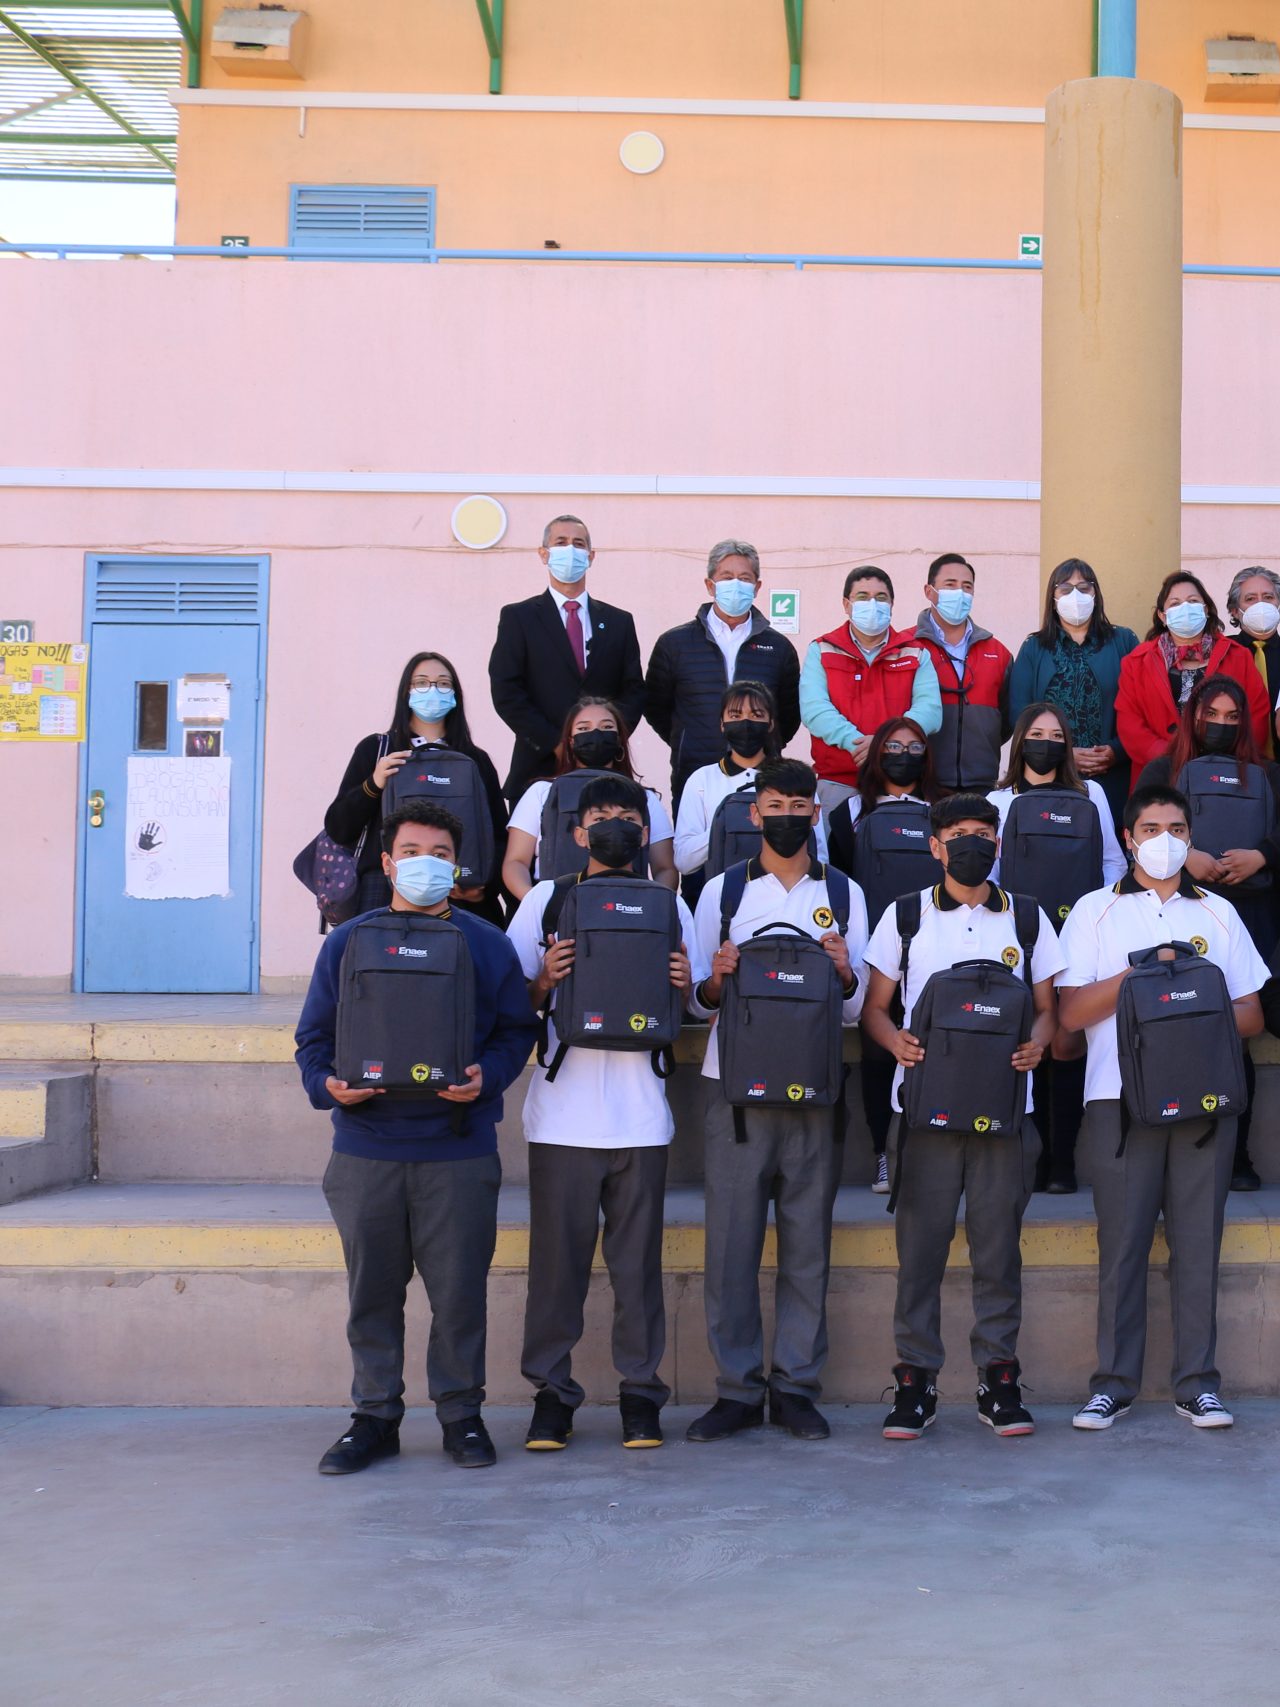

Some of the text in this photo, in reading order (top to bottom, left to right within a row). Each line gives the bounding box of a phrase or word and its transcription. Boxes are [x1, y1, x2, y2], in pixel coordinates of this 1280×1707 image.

[3, 624, 30, 643] 30
[428, 775, 450, 783] Enaex
[1050, 813, 1071, 822] Enaex
[902, 828, 924, 836] Enaex
[616, 903, 642, 912] Enaex
[399, 946, 427, 955] Enaex
[778, 972, 804, 981] Enaex
[1171, 990, 1196, 1000] Enaex
[974, 1004, 1000, 1014] Enaex
[363, 1072, 381, 1080] AIEP
[1162, 1108, 1178, 1116] AIEP
[930, 1118, 947, 1127] AIEP
